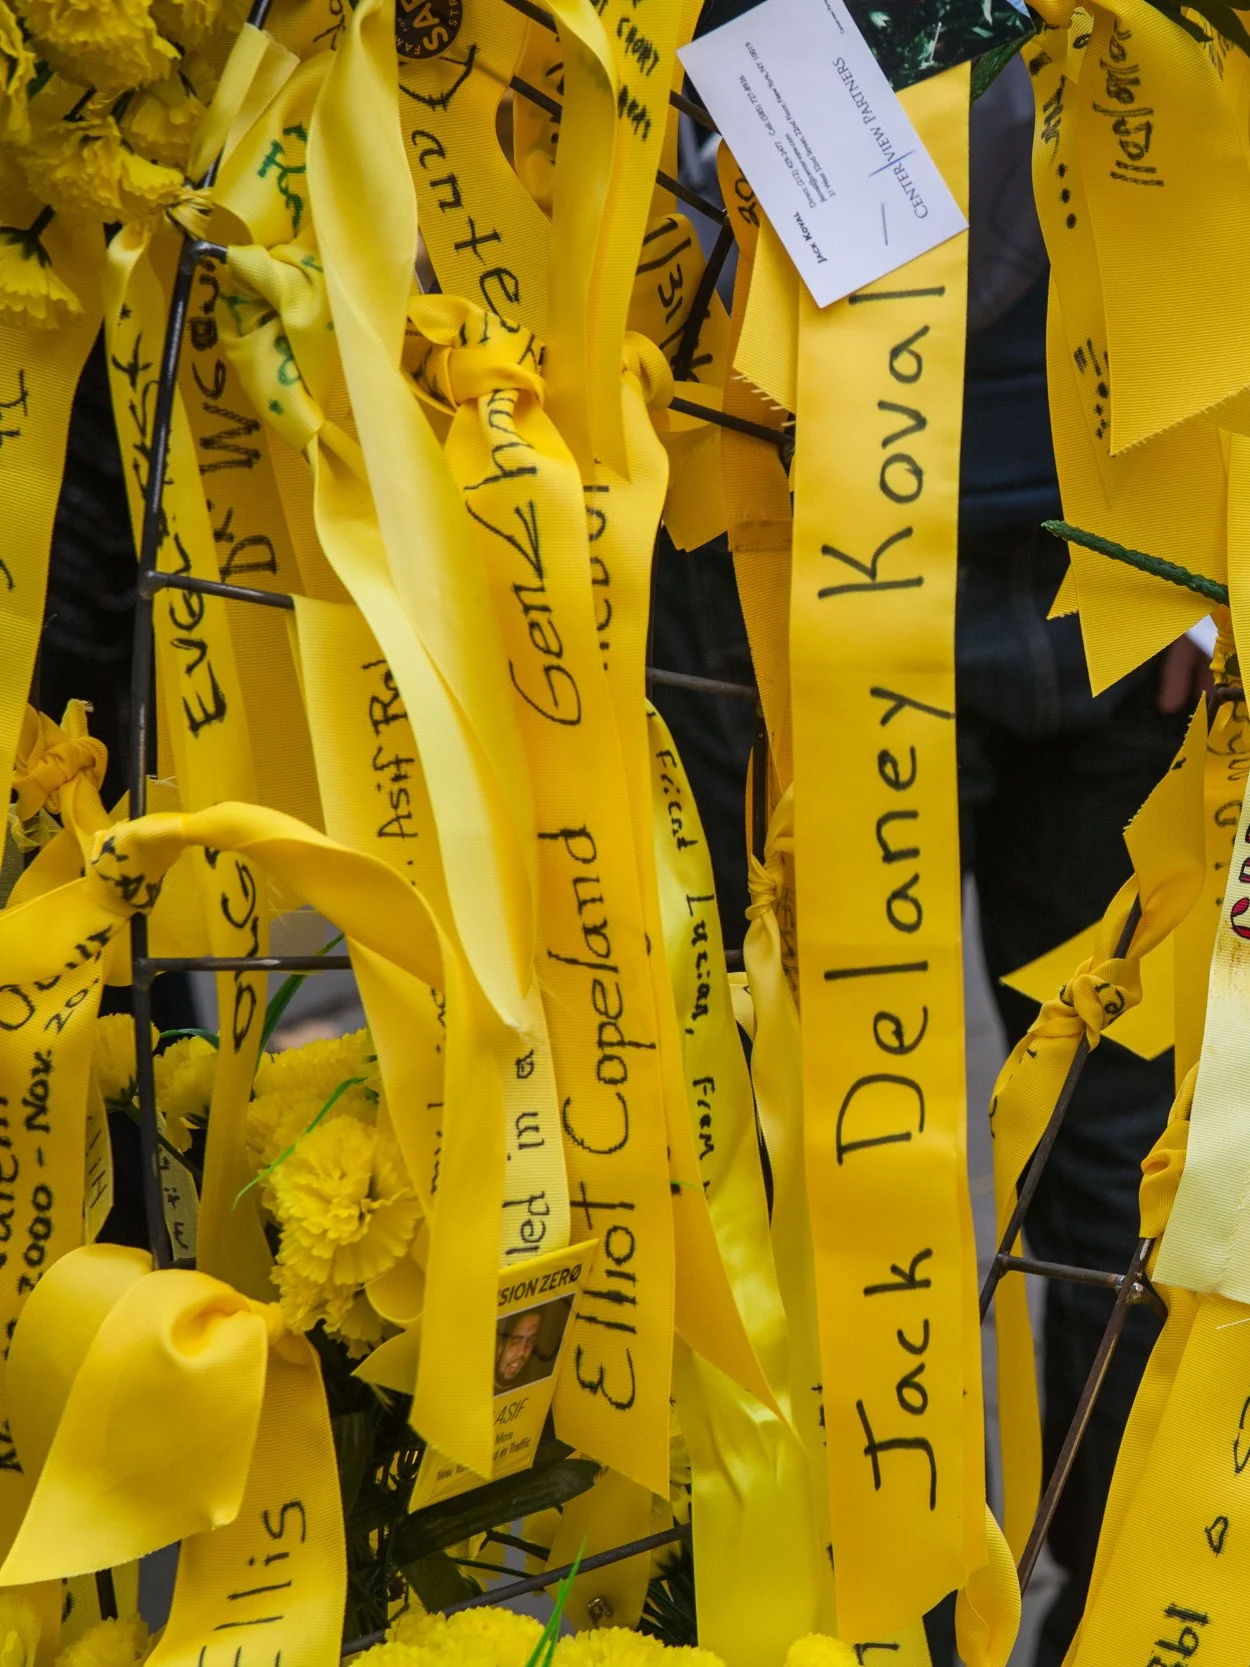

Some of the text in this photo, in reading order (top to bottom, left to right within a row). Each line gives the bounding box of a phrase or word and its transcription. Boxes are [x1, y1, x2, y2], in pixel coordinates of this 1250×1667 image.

[829, 56, 877, 125] PARTNERS
[791, 211, 828, 266] JACK KOVAL
[817, 284, 957, 1512] Jack Delaney Koval
[537, 824, 656, 1155] Copeland
[505, 1108, 547, 1160] in
[498, 1277, 540, 1307] SION
[570, 1178, 638, 1412] Elliot
